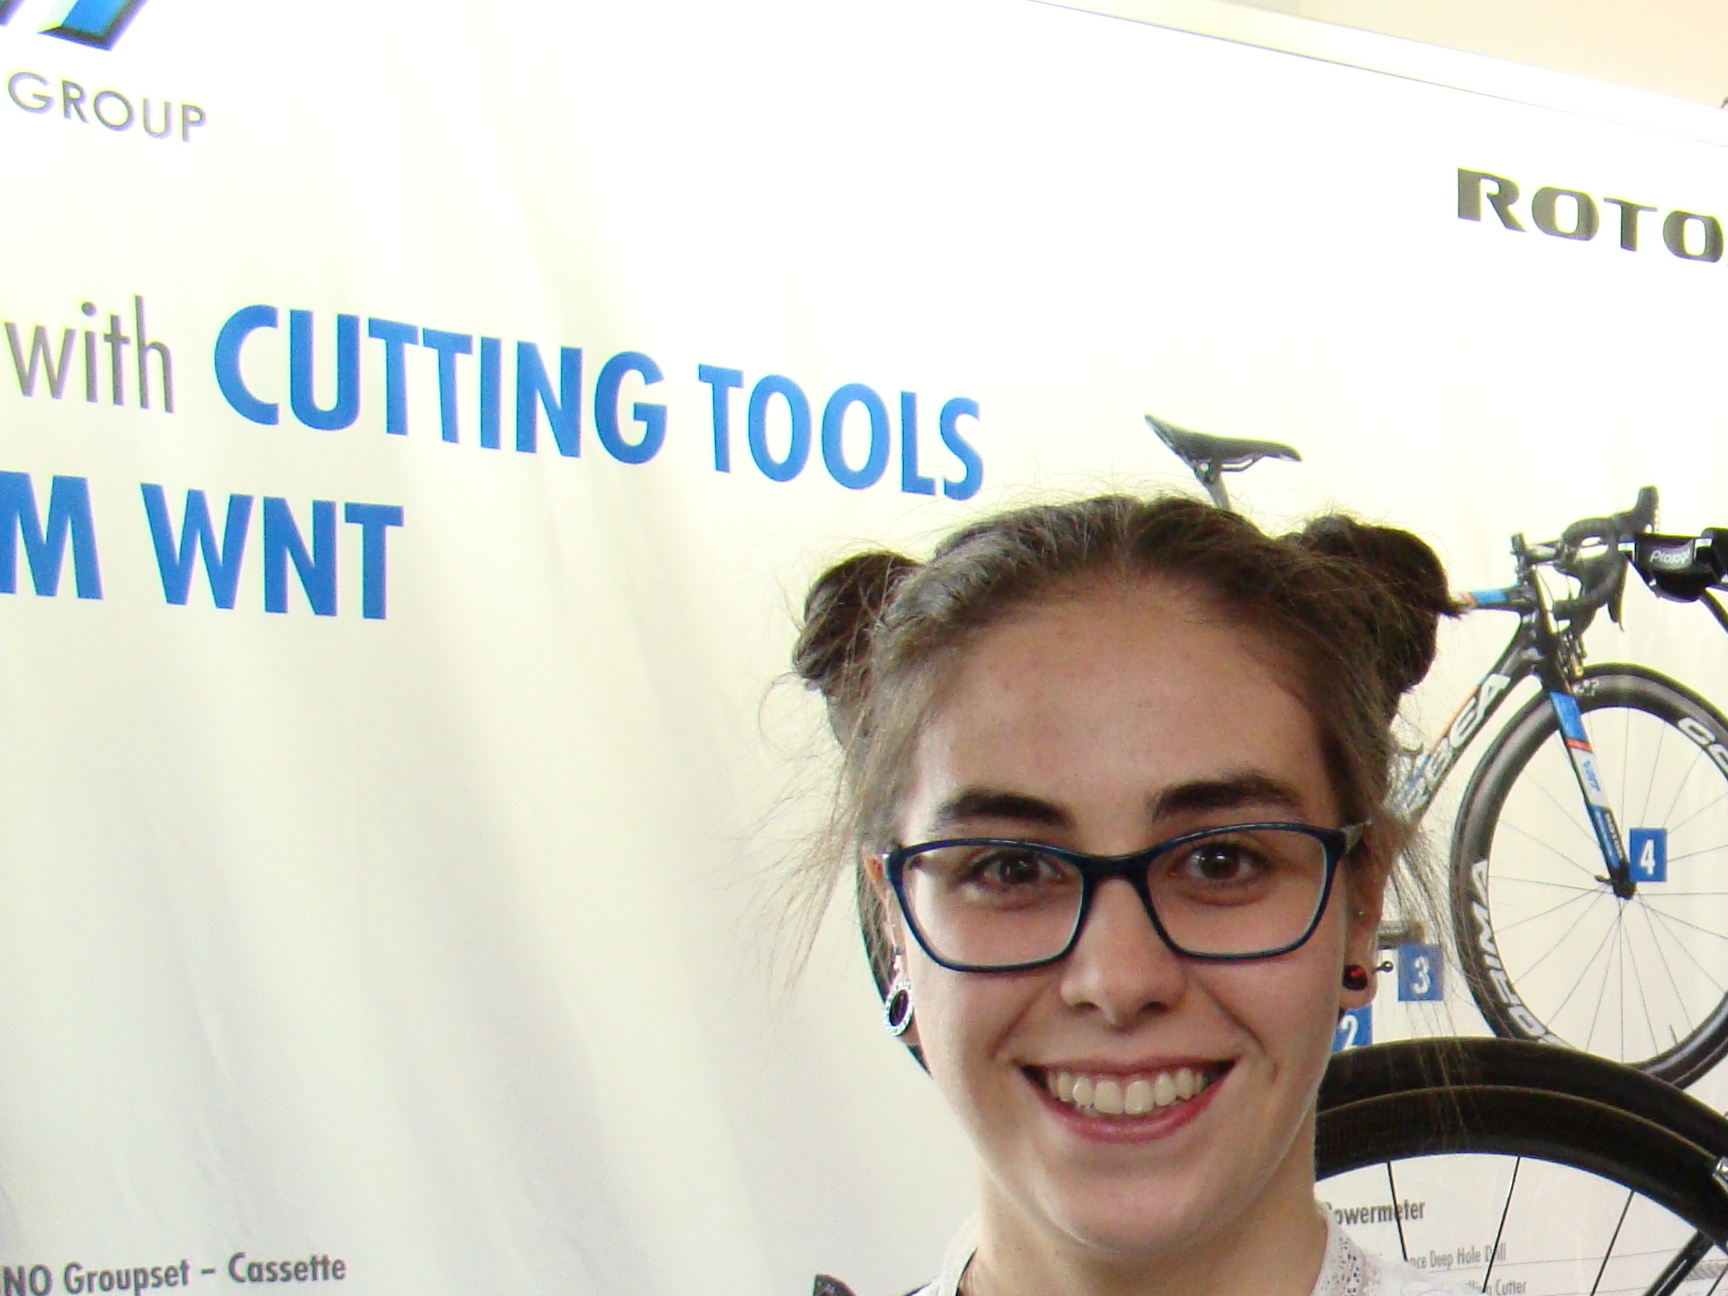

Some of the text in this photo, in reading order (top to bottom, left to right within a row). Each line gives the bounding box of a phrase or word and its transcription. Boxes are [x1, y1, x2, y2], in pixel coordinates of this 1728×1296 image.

[8, 70, 206, 143] GROUP
[4, 295, 983, 501] with CUTTING TOOLS
[140, 482, 404, 620] WNT
[1640, 839, 1656, 875] 4
[1413, 956, 1431, 994] 3
[1341, 1014, 1363, 1050] 2
[1326, 1199, 1427, 1226] owermeter
[228, 1252, 347, 1283] Cassette
[1430, 1250, 1454, 1271] Deep
[1457, 1247, 1481, 1264] Hole
[1495, 1279, 1527, 1296] Cutter
